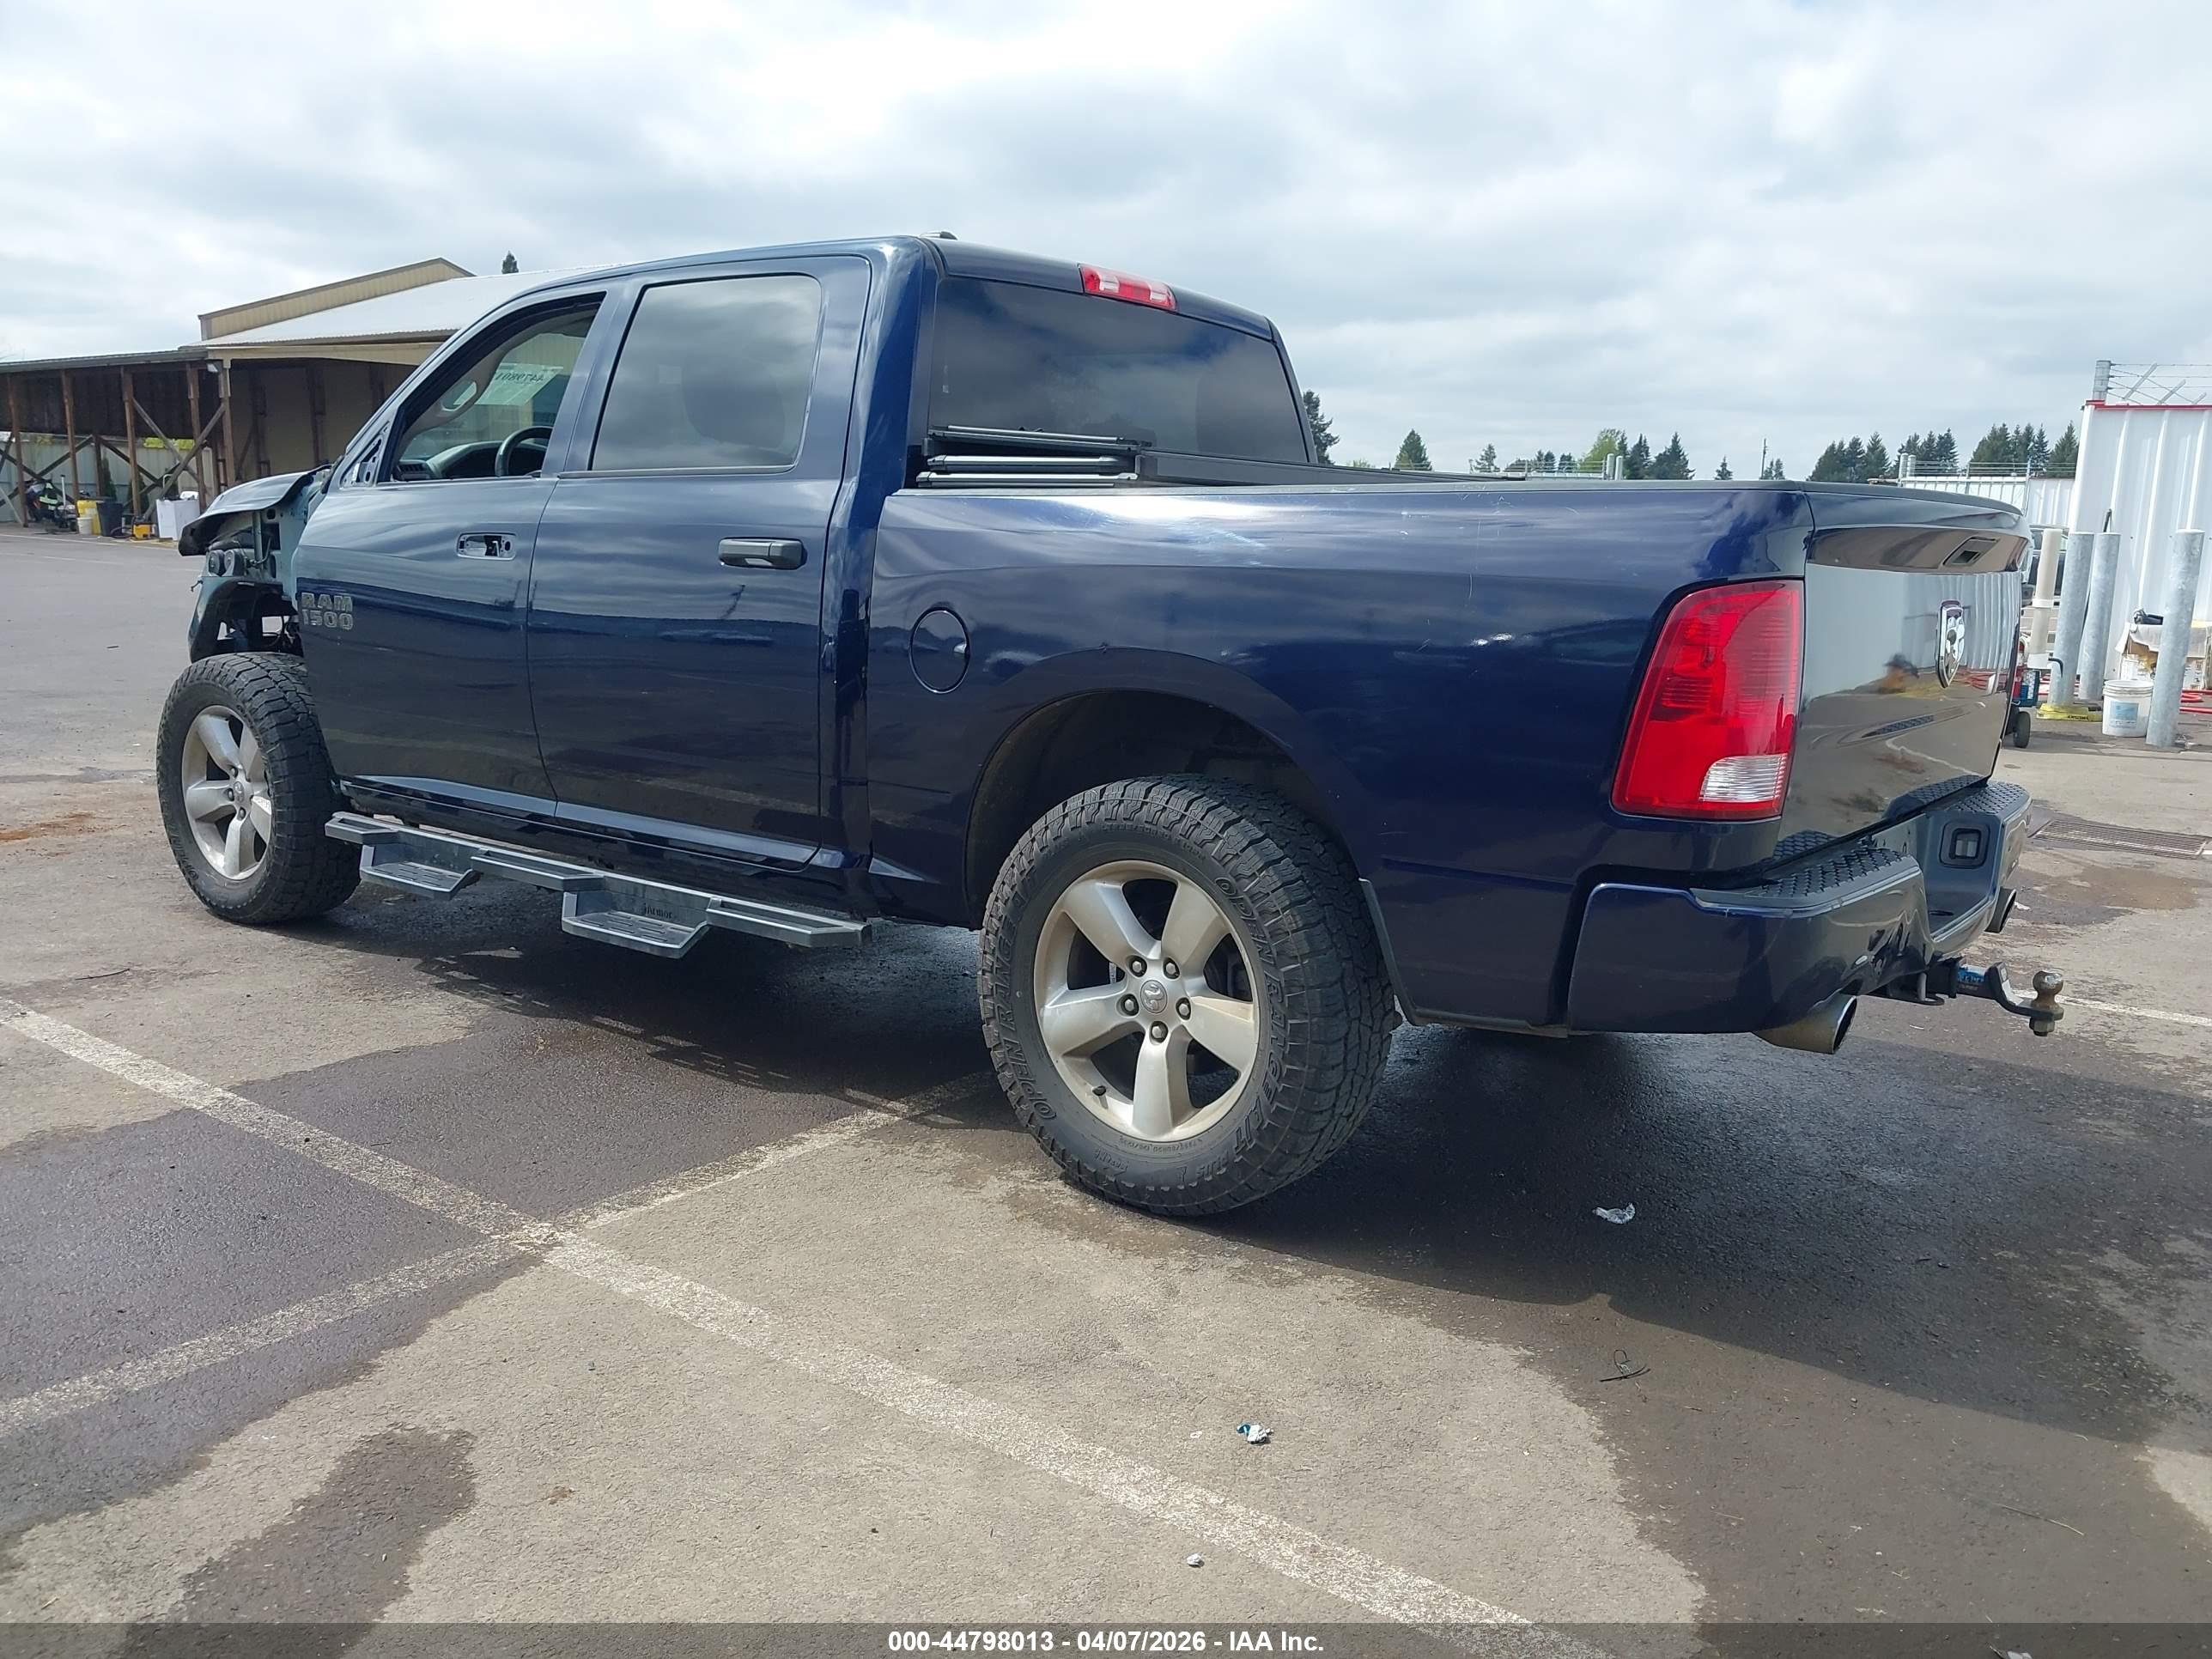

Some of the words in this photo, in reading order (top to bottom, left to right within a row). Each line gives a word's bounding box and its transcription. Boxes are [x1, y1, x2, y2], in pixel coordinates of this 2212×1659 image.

[301, 592, 353, 612] RAM
[301, 609, 353, 630] 1500
[994, 915, 1018, 1031] RANGE
[1002, 1036, 1057, 1120] OPEN
